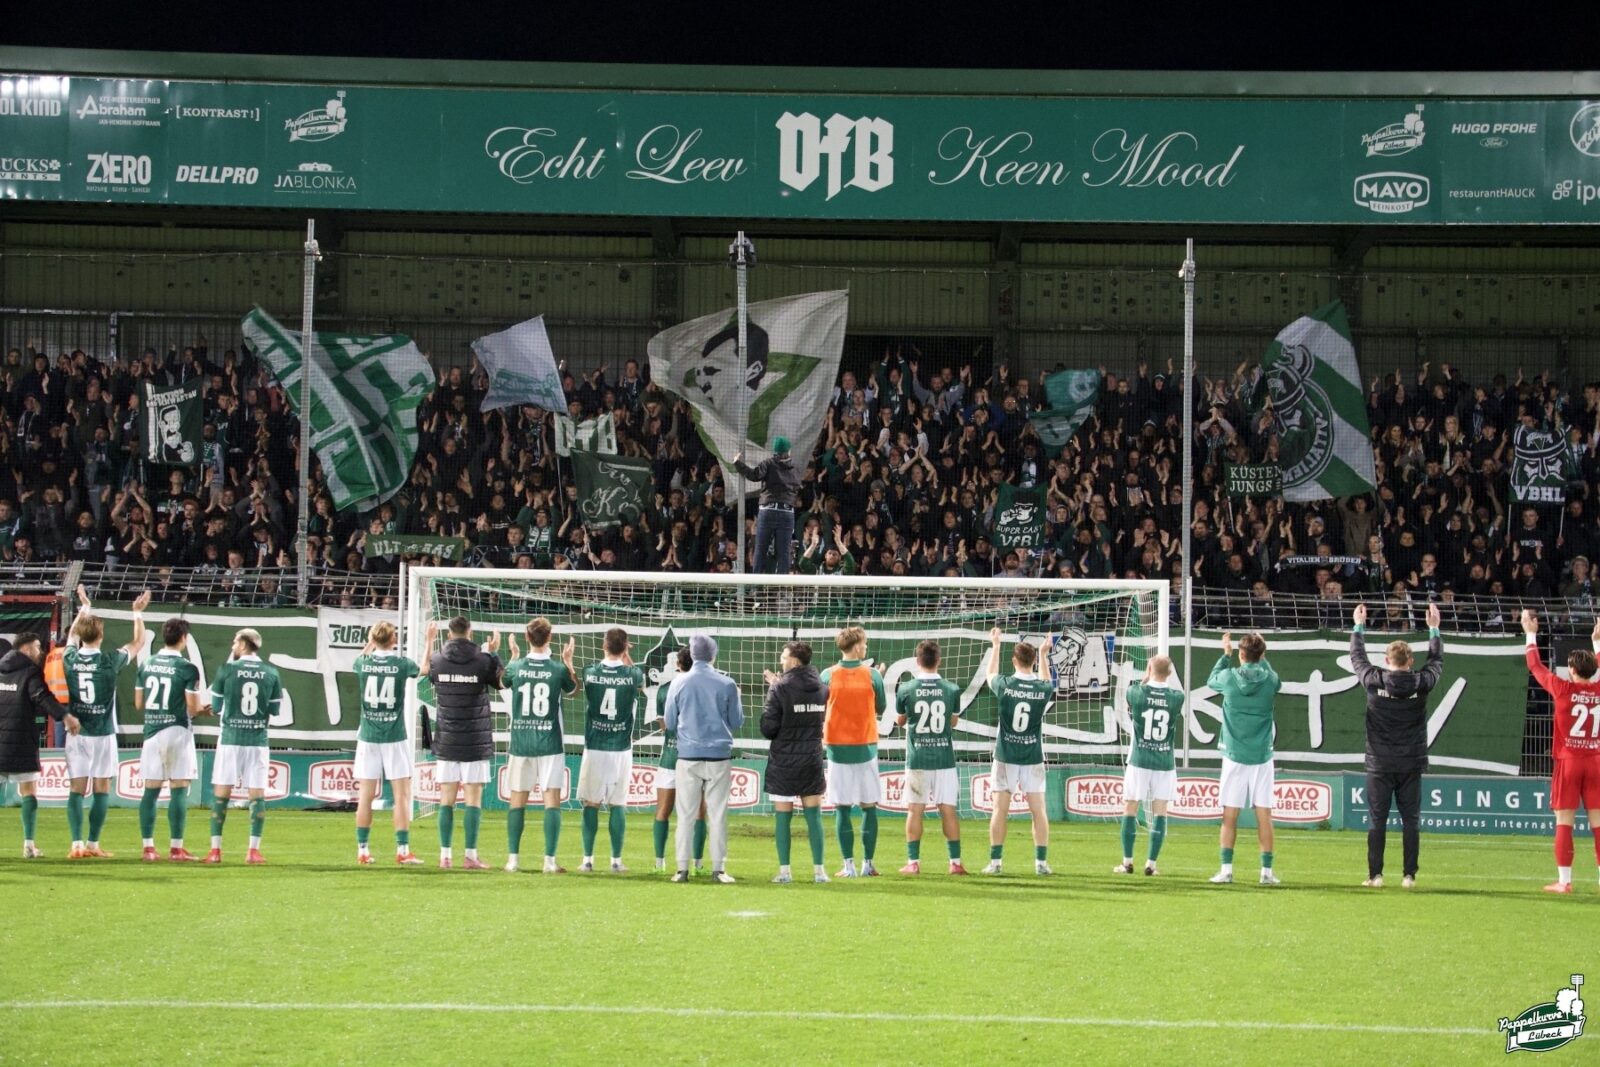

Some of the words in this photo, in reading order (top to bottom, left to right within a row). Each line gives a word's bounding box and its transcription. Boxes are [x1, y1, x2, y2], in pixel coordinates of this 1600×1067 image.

[76, 94, 147, 119] Abraham
[1451, 123, 1490, 135] HUGO
[1492, 123, 1538, 134] PFOHE
[485, 126, 606, 184] Echt
[625, 124, 748, 184] Leev
[775, 111, 894, 201] VfB
[928, 126, 1071, 187] Keen
[1081, 128, 1245, 187] Mood
[0, 157, 49, 172] ÜCKS
[176, 165, 259, 184] DELLPRO
[274, 174, 357, 189] JABLONKA
[1361, 182, 1423, 199] MAYO
[1577, 180, 1600, 206] ip
[1372, 202, 1411, 212] FEINKOST
[1229, 480, 1273, 494] JUNGS
[1513, 485, 1566, 503] VBHL
[144, 664, 177, 675] ANDREAS
[237, 670, 266, 680] POLAT
[361, 664, 399, 674] LEHNFELD
[518, 669, 553, 679] PHILIPP
[78, 673, 96, 704] 5
[145, 676, 172, 710] 27
[364, 675, 396, 710] 44
[915, 688, 943, 698] DEMIR
[1003, 687, 1046, 700] PFUNDHELLER
[241, 681, 259, 716] 8
[518, 682, 550, 717] 18
[599, 688, 618, 721] 4
[1146, 697, 1169, 707] THIEL
[1570, 693, 1600, 704] DIESTE
[914, 700, 946, 734] 28
[1012, 701, 1031, 733] 6
[1141, 708, 1170, 741] 13
[1569, 703, 1600, 738] 21
[321, 767, 355, 780] MAY
[38, 777, 71, 788] ÜBEC
[321, 779, 361, 791] LÜBEC
[628, 785, 654, 796] ECK
[1077, 782, 1124, 795] MAYO
[1077, 795, 1123, 806] LÜBECK
[1173, 796, 1220, 808] LÜBECK
[1351, 787, 1551, 812] KSINGT
[1420, 817, 1486, 831] roperties
[1493, 818, 1592, 834] Internatal
